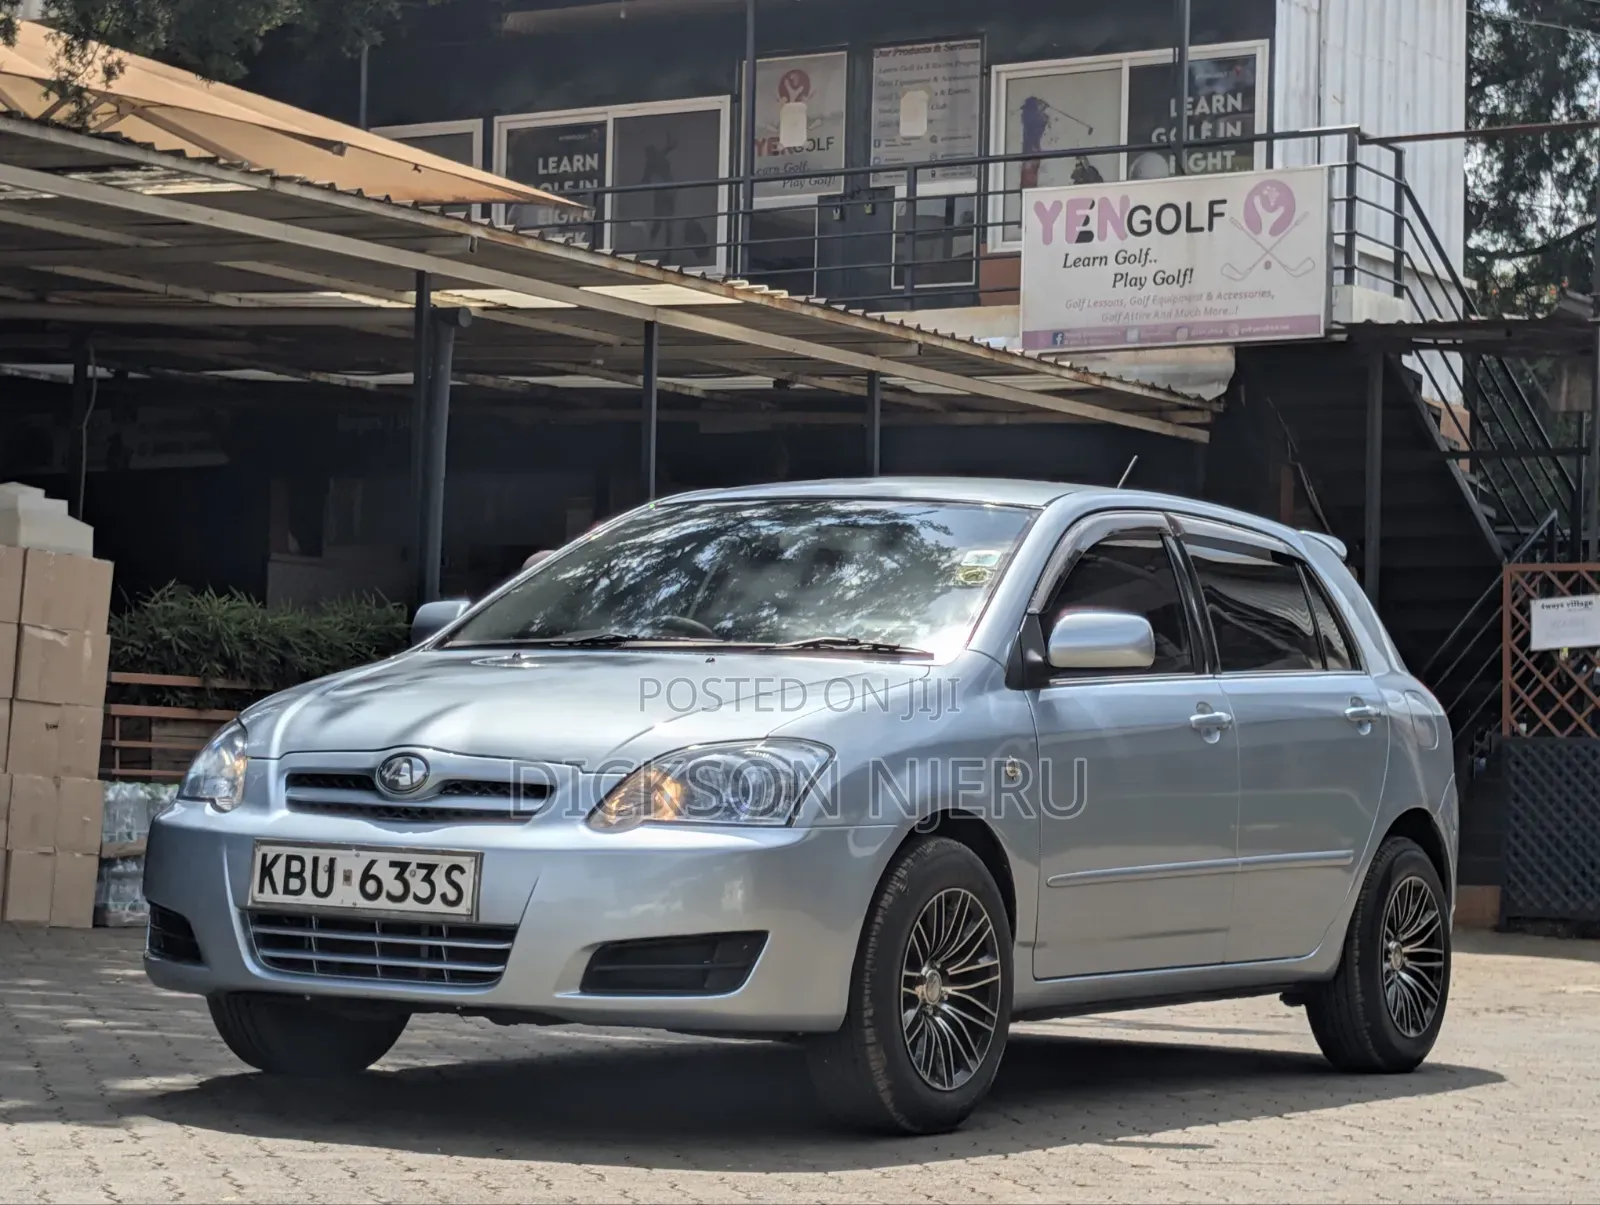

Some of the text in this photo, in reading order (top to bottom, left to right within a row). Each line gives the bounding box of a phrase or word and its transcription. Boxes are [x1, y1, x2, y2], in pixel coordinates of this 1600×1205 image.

[1170, 92, 1242, 118] LEARN
[1217, 121, 1242, 138] IN
[538, 153, 599, 175] LEARN
[756, 165, 780, 177] earn
[1033, 194, 1228, 246] YENGOLF
[1062, 248, 1158, 269] Learn Golf..
[1112, 268, 1194, 291] Play Golf!
[1065, 297, 1086, 311] Golf
[1129, 294, 1150, 308] Golf
[1206, 291, 1213, 301] &
[1101, 309, 1123, 323] Golf
[1566, 600, 1594, 609] village
[257, 852, 467, 908] KBU 633S
